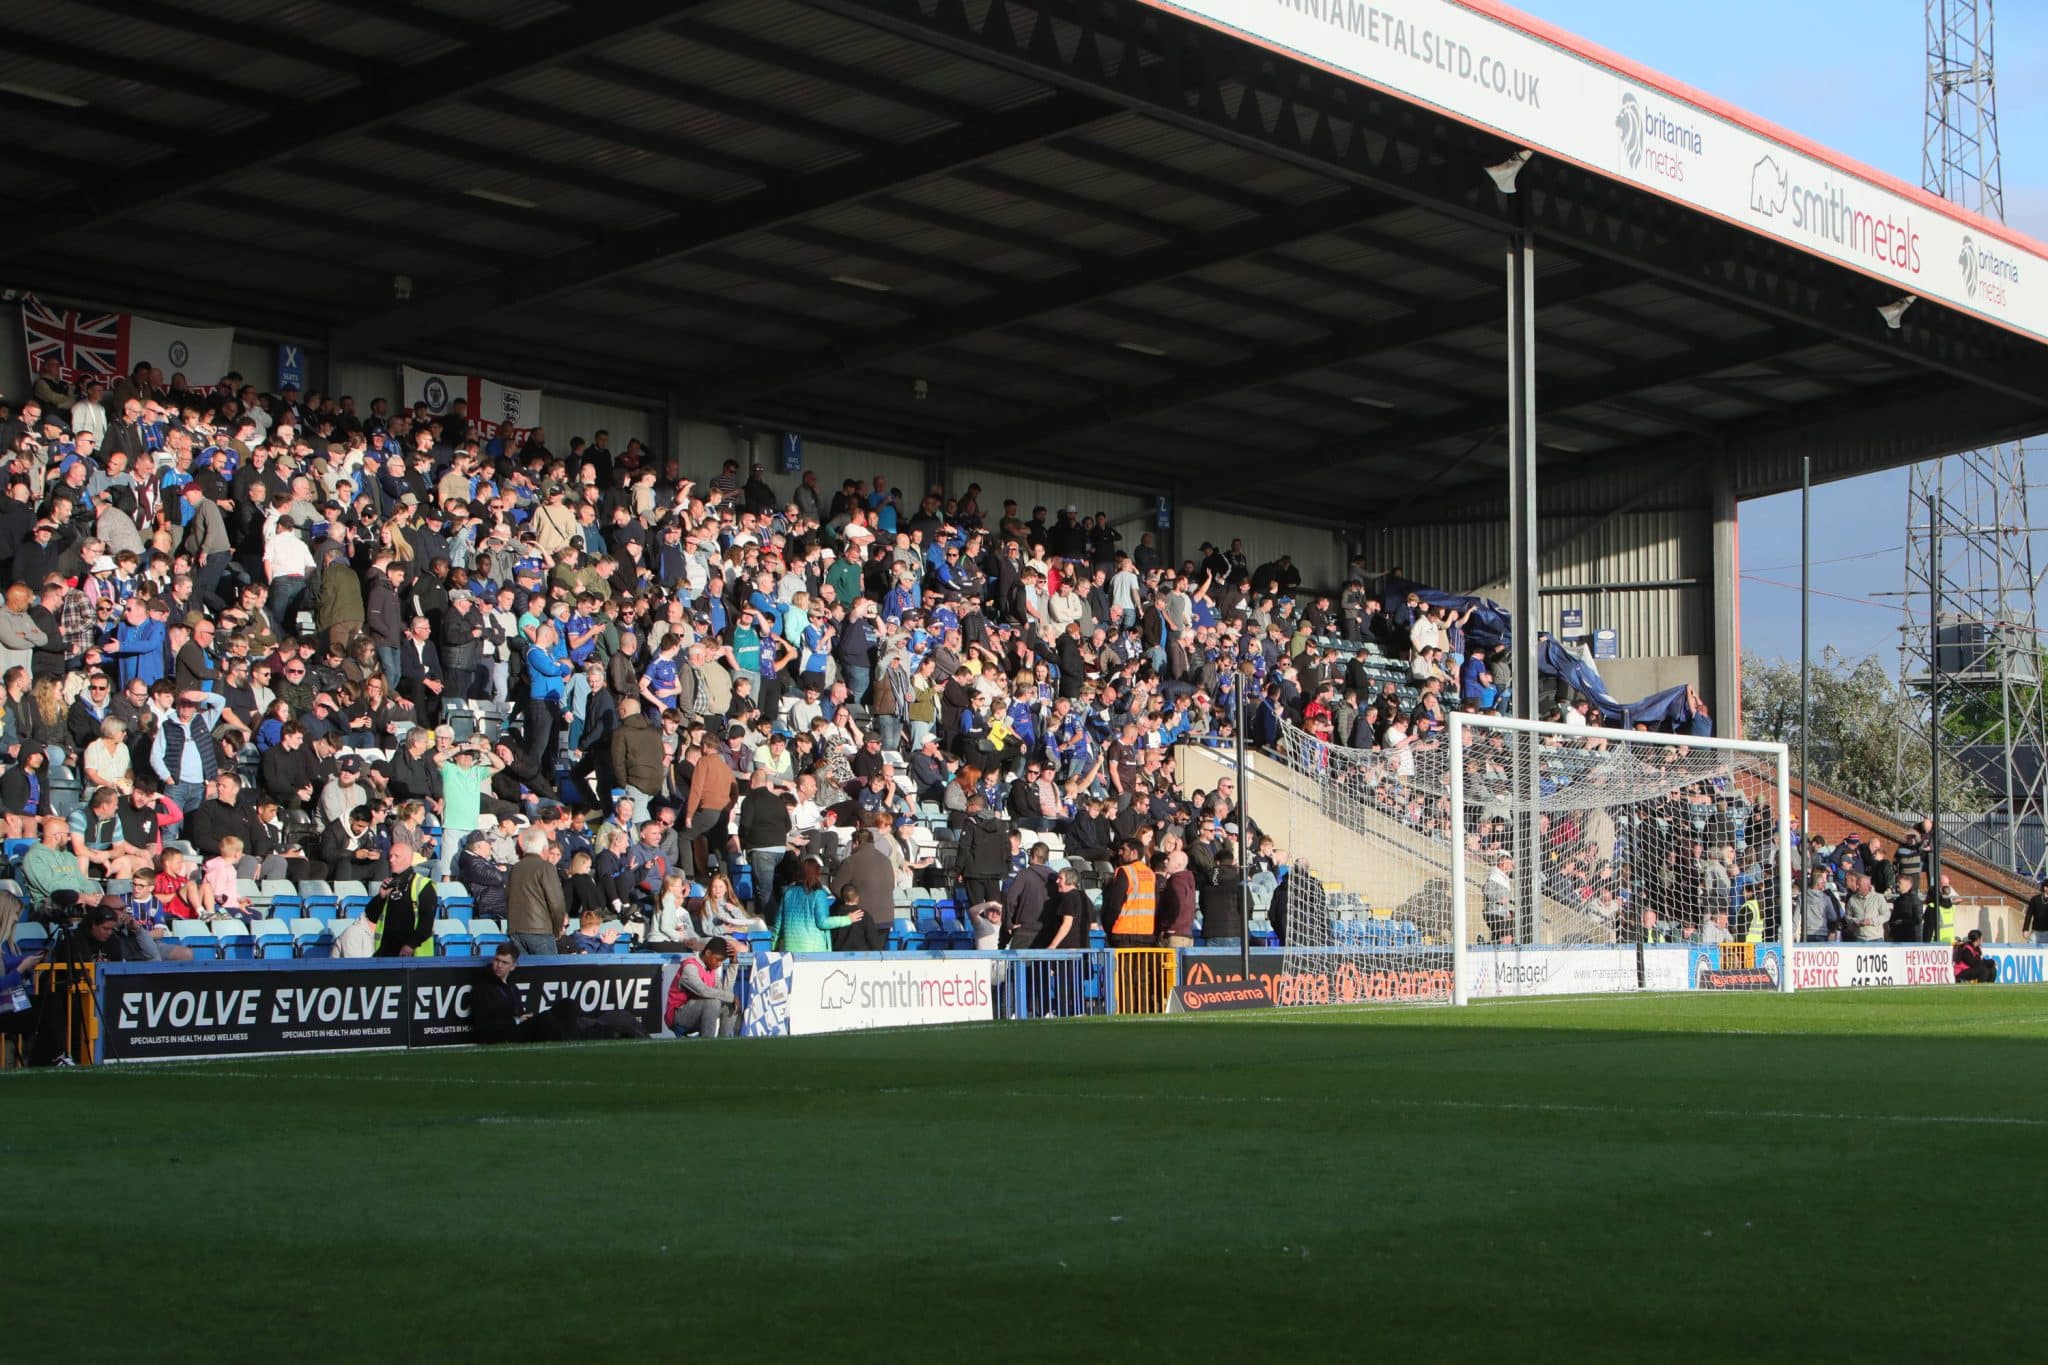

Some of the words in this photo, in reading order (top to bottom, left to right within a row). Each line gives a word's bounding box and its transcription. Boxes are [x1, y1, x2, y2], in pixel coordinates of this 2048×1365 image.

[1278, 0, 1541, 108] NIAMETALSLTD.CO.UK
[1645, 105, 1702, 156] britannia
[1645, 147, 1684, 182] metals
[1792, 180, 1921, 274] smithmetals
[1978, 244, 2019, 285] britannia
[1977, 278, 2008, 307] metals
[286, 346, 297, 368] X
[788, 433, 798, 452] Y
[1160, 496, 1167, 512] Z
[1856, 954, 1888, 973] 01706
[1905, 949, 1949, 965] HEYWOOD
[1984, 954, 2043, 984] ROWN
[1495, 959, 1548, 986] Managed
[1907, 966, 1949, 985] PLASTICS
[538, 978, 651, 1013] EVOLVE
[861, 970, 988, 1008] smithmetals
[1200, 987, 1264, 1004] vanarama
[118, 989, 261, 1029] EVOLVE
[271, 985, 402, 1024] EVOLVE
[130, 1036, 169, 1045] SPECIALISTS
[178, 1034, 201, 1043] HEALTH
[203, 1033, 216, 1042] AND
[217, 1032, 249, 1041] WELLNESS
[282, 1030, 319, 1039] SPECIALISTS
[326, 1029, 349, 1037] HEALTH
[362, 1027, 391, 1035] WELLNESS
[424, 1026, 456, 1035] SPECIALISTS
